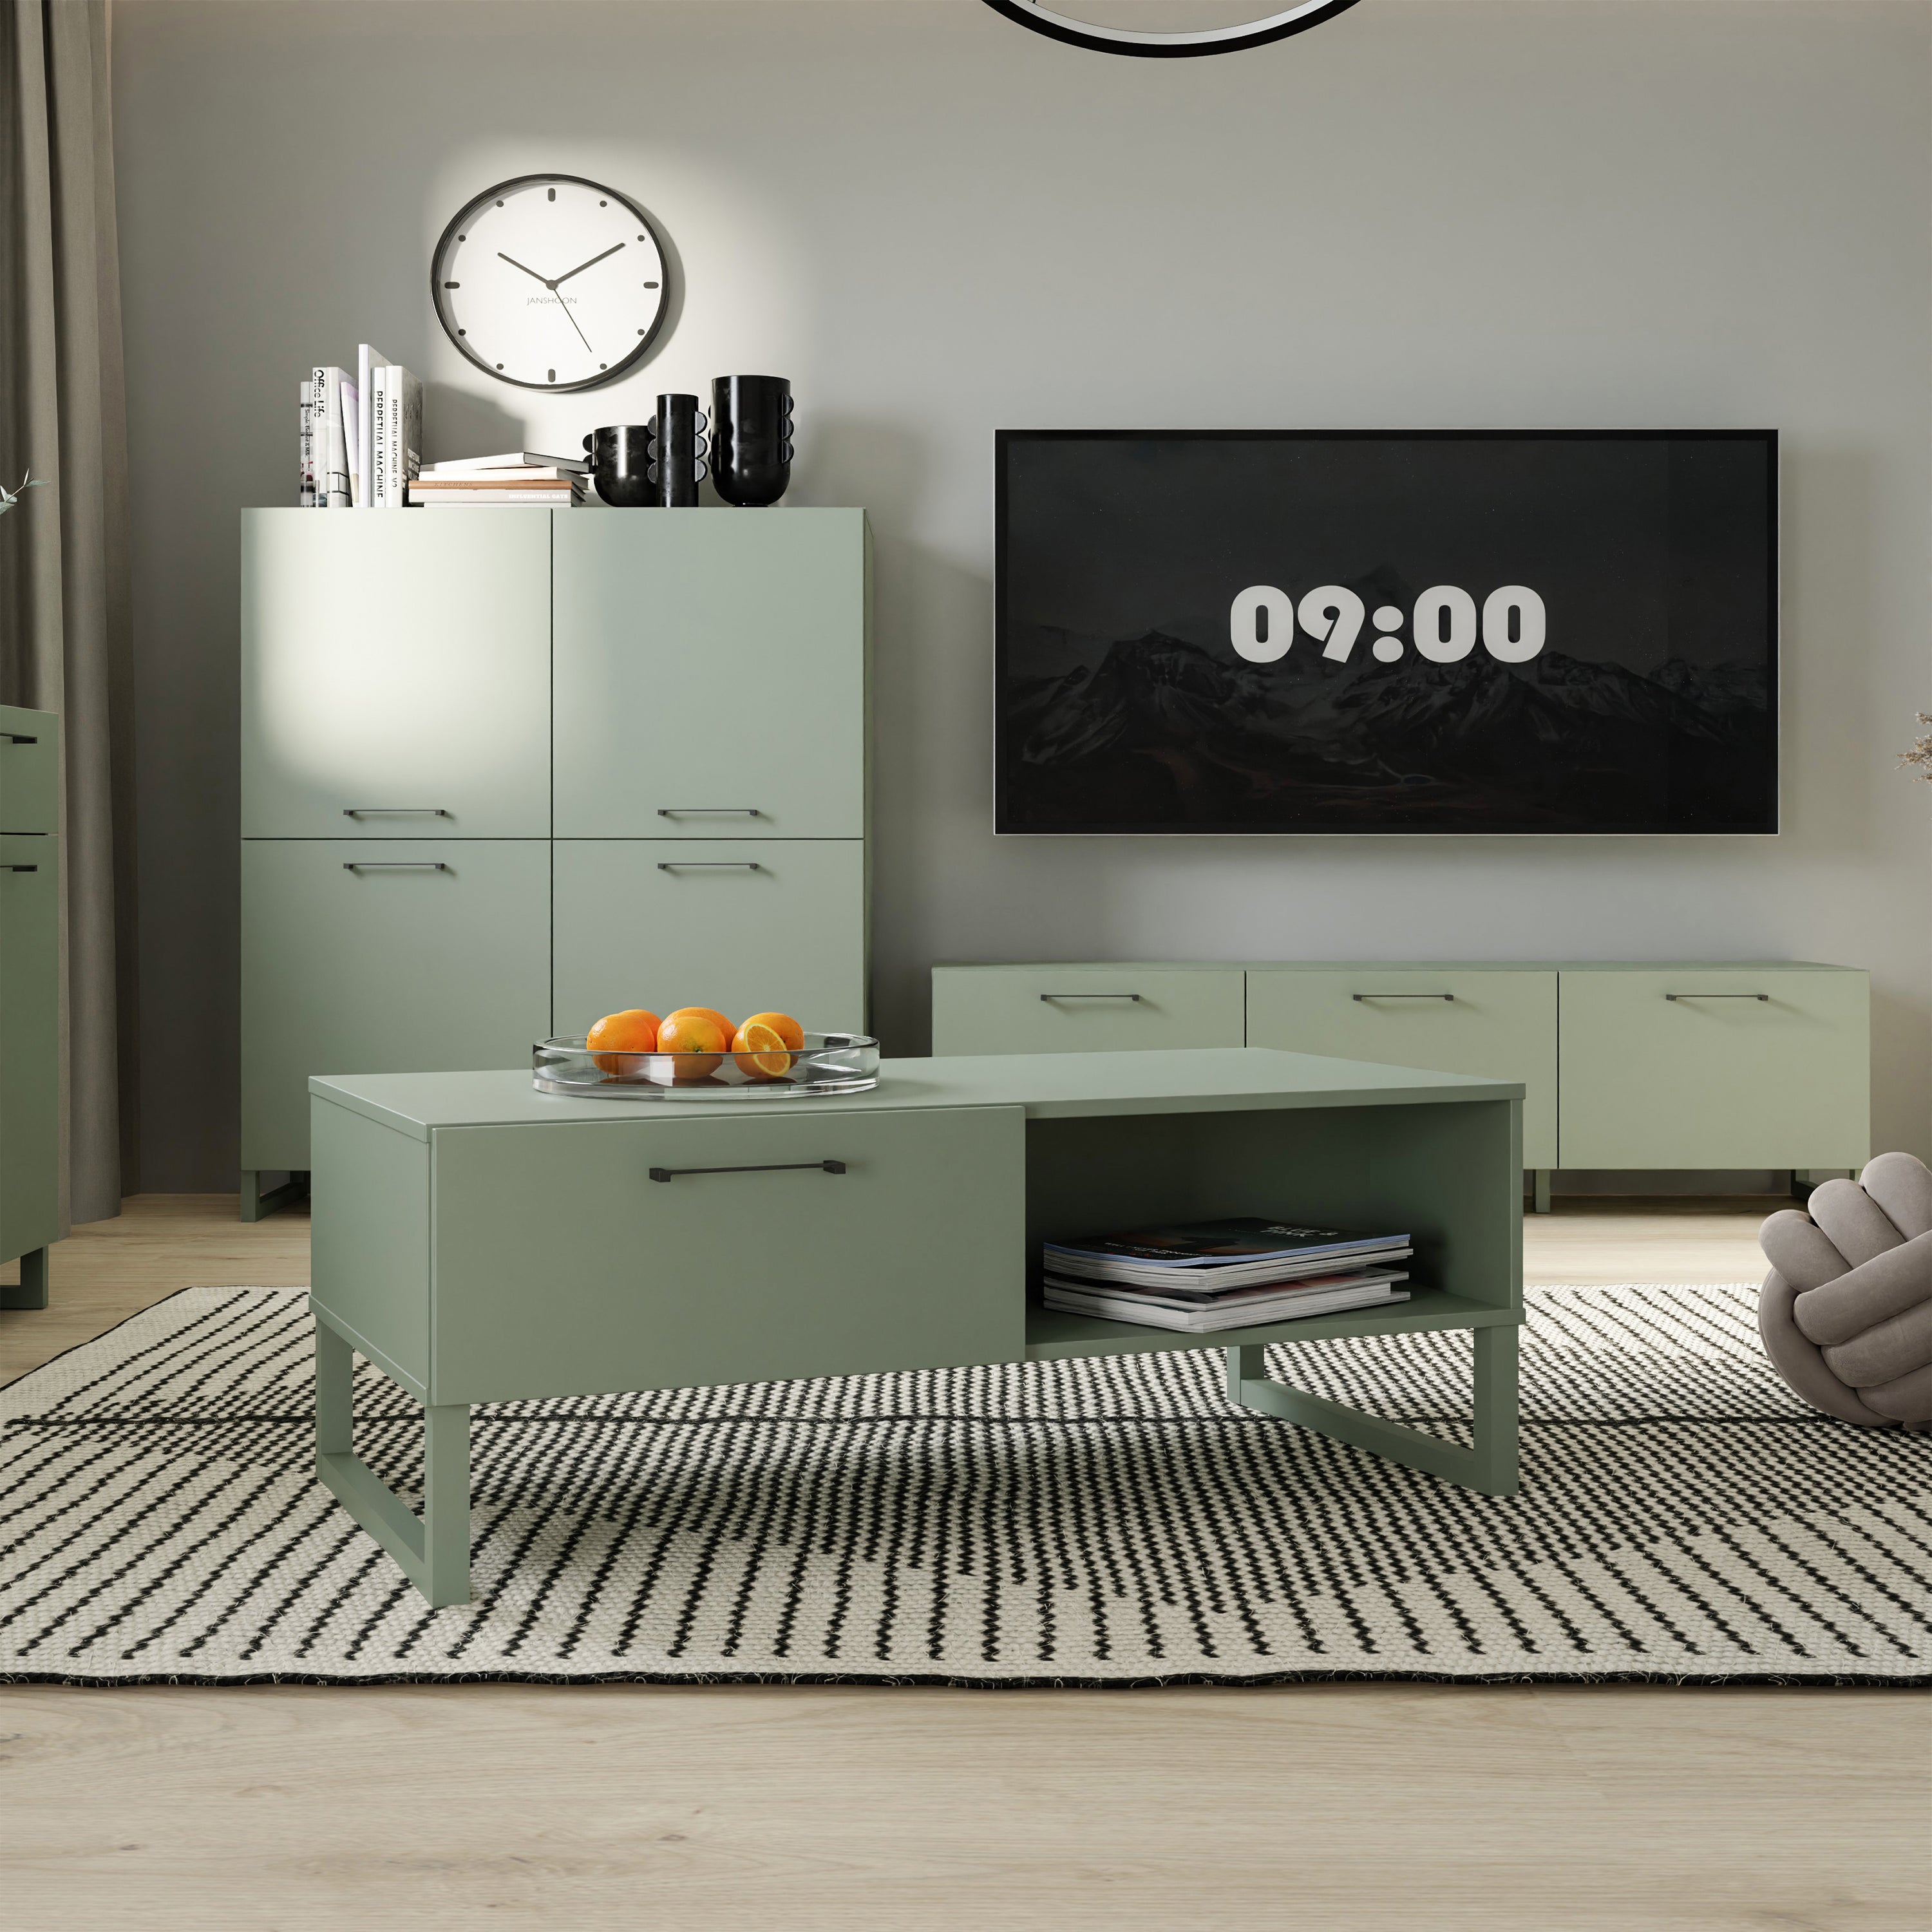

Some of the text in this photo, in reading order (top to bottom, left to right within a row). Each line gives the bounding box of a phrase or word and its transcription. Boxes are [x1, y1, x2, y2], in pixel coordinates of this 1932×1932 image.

[527, 297, 577, 306] JANSHOON
[314, 370, 325, 417] Office Life
[1230, 585, 1546, 663] 09:00
